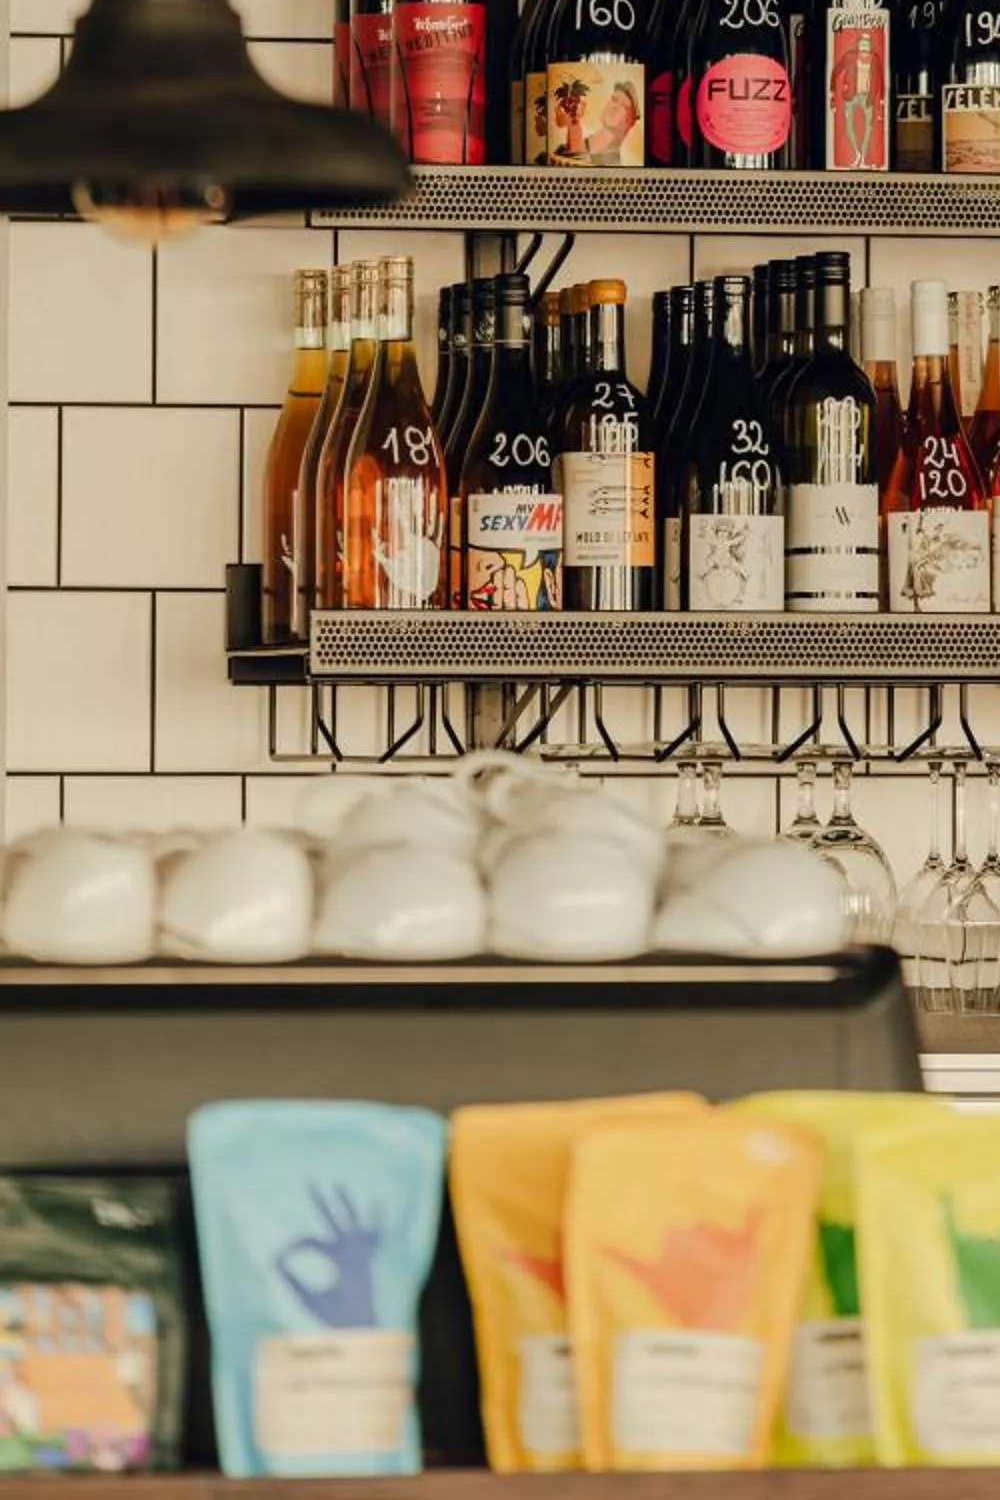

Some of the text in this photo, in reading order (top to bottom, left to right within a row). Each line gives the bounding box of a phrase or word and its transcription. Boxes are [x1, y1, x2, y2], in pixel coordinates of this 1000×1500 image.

[707, 78, 787, 102] FUZZ
[591, 382, 636, 409] 27
[381, 425, 441, 468] 181
[489, 433, 550, 467] 206
[731, 419, 769, 455] 32
[923, 436, 961, 469] 24
[719, 460, 771, 494] 160
[919, 469, 967, 500] 120
[480, 516, 529, 531] SEXY
[516, 503, 533, 514] MY
